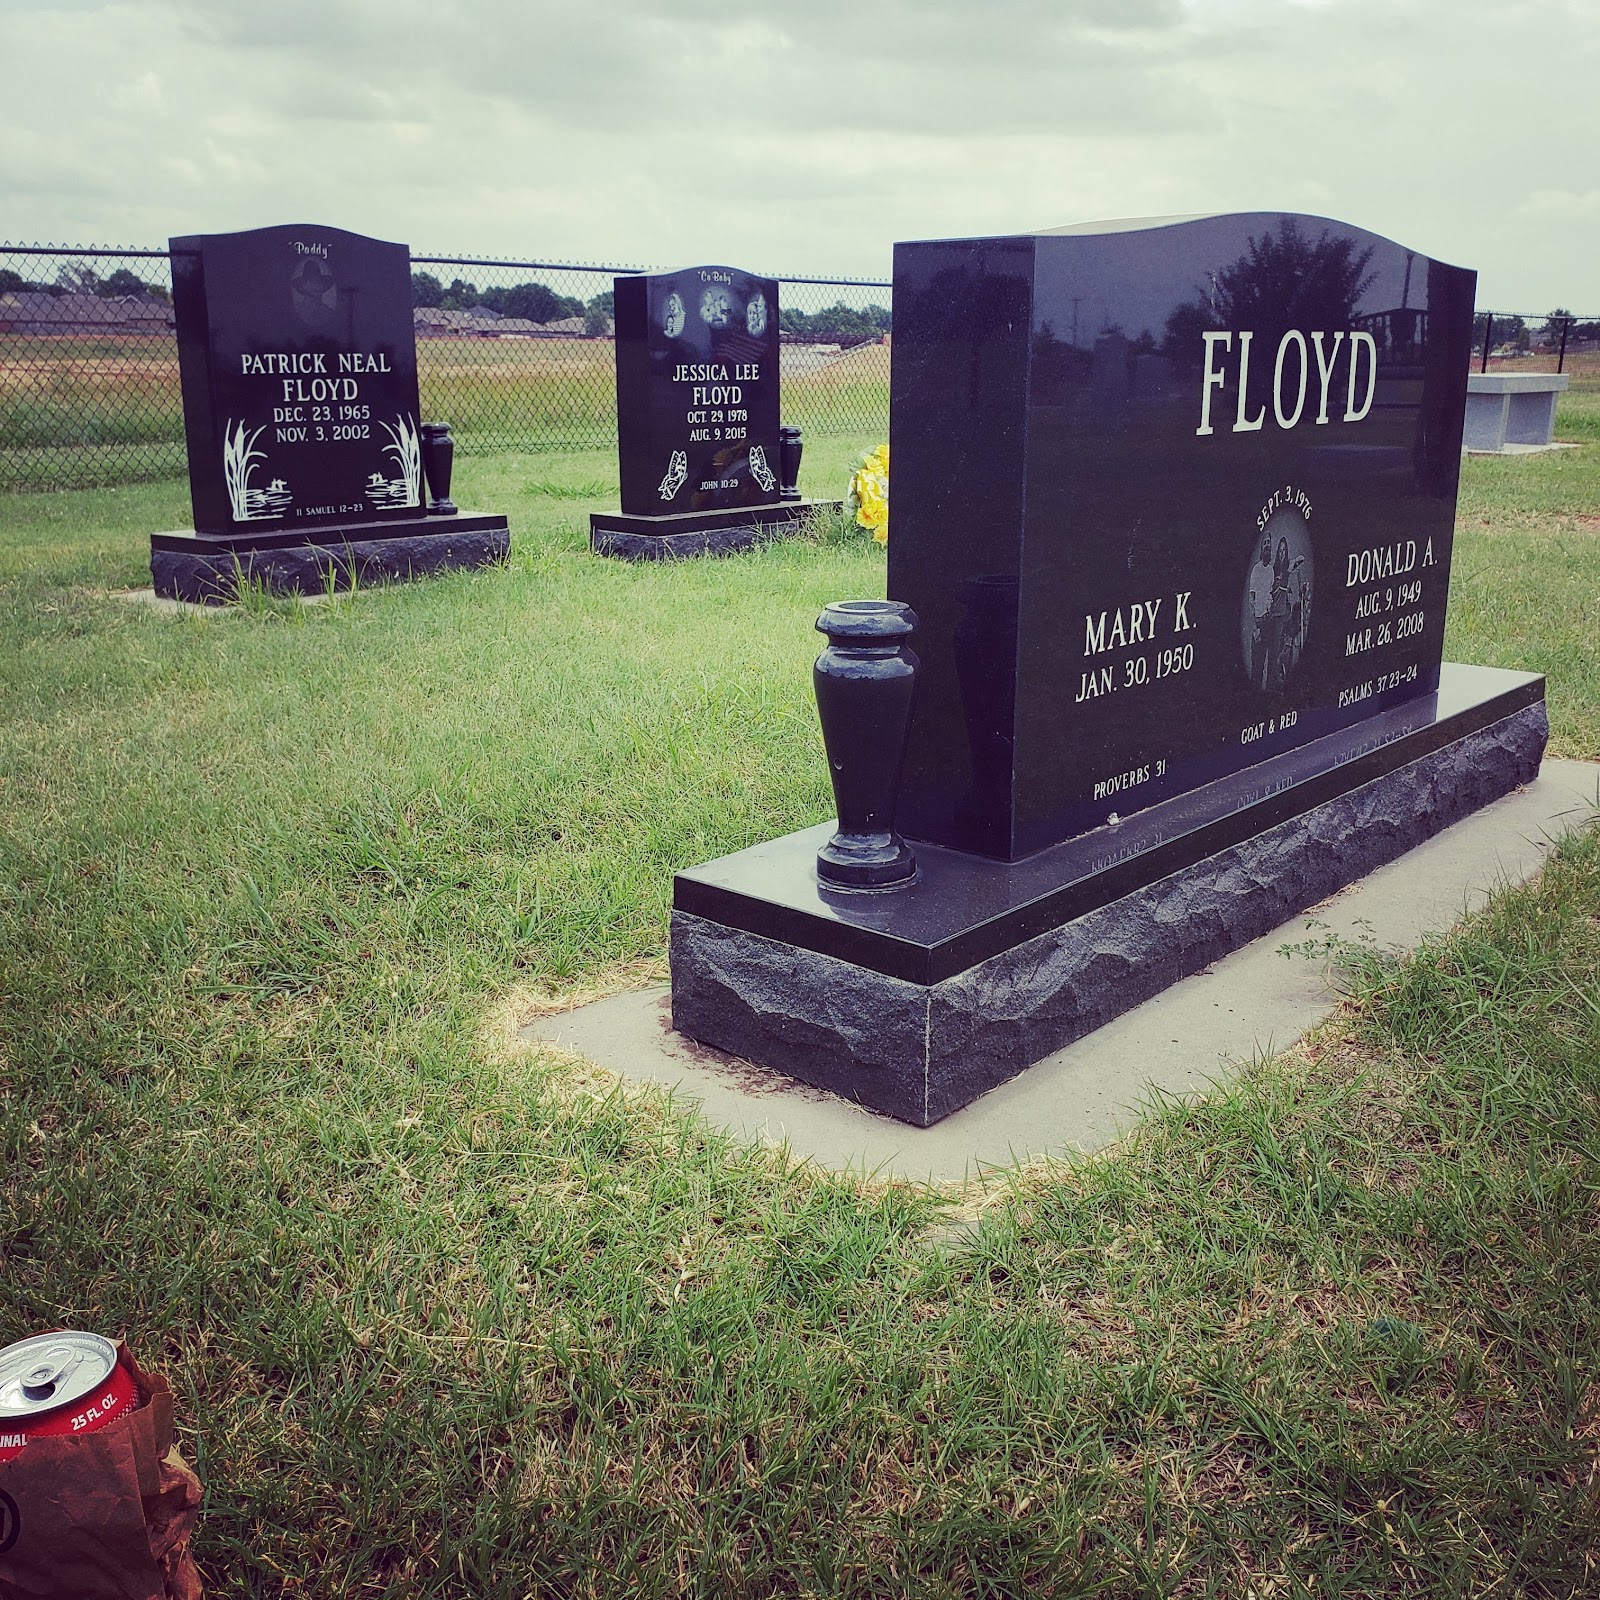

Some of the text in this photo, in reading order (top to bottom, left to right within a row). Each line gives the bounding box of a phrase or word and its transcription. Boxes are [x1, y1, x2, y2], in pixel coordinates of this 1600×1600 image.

[241, 353, 392, 374] PATRICK NEAL
[672, 364, 760, 382] JESSICA LEE
[283, 378, 358, 401] FLOYD
[692, 386, 742, 405] FLOYD
[1196, 329, 1377, 436] FLOYD
[273, 407, 307, 423] DEC.
[339, 405, 371, 420] 1965
[687, 410, 708, 424] OCT.
[727, 409, 748, 422] 1978
[276, 427, 309, 443] NOV.
[333, 425, 371, 441] 2002
[689, 429, 712, 442] AUG.
[725, 427, 747, 440] 2015
[699, 480, 718, 491] JOHN
[305, 506, 336, 516] SAMUEL
[339, 503, 363, 513] 12-23
[1257, 485, 1313, 532] SEPT. 3, 1976
[1346, 536, 1438, 587] DONALD A.
[1355, 580, 1421, 619] AUG. 9, 1949
[1083, 591, 1197, 657] MARY K.
[1345, 611, 1424, 656] MAR. 26, 2008
[1075, 644, 1194, 703] JAN. 30, 1950
[1338, 680, 1373, 708] PSALMS
[1241, 711, 1298, 744] GOAT & RED
[1093, 759, 1166, 801] PROVERBS 31
[71, 1393, 118, 1431] 25 FL. OZ.
